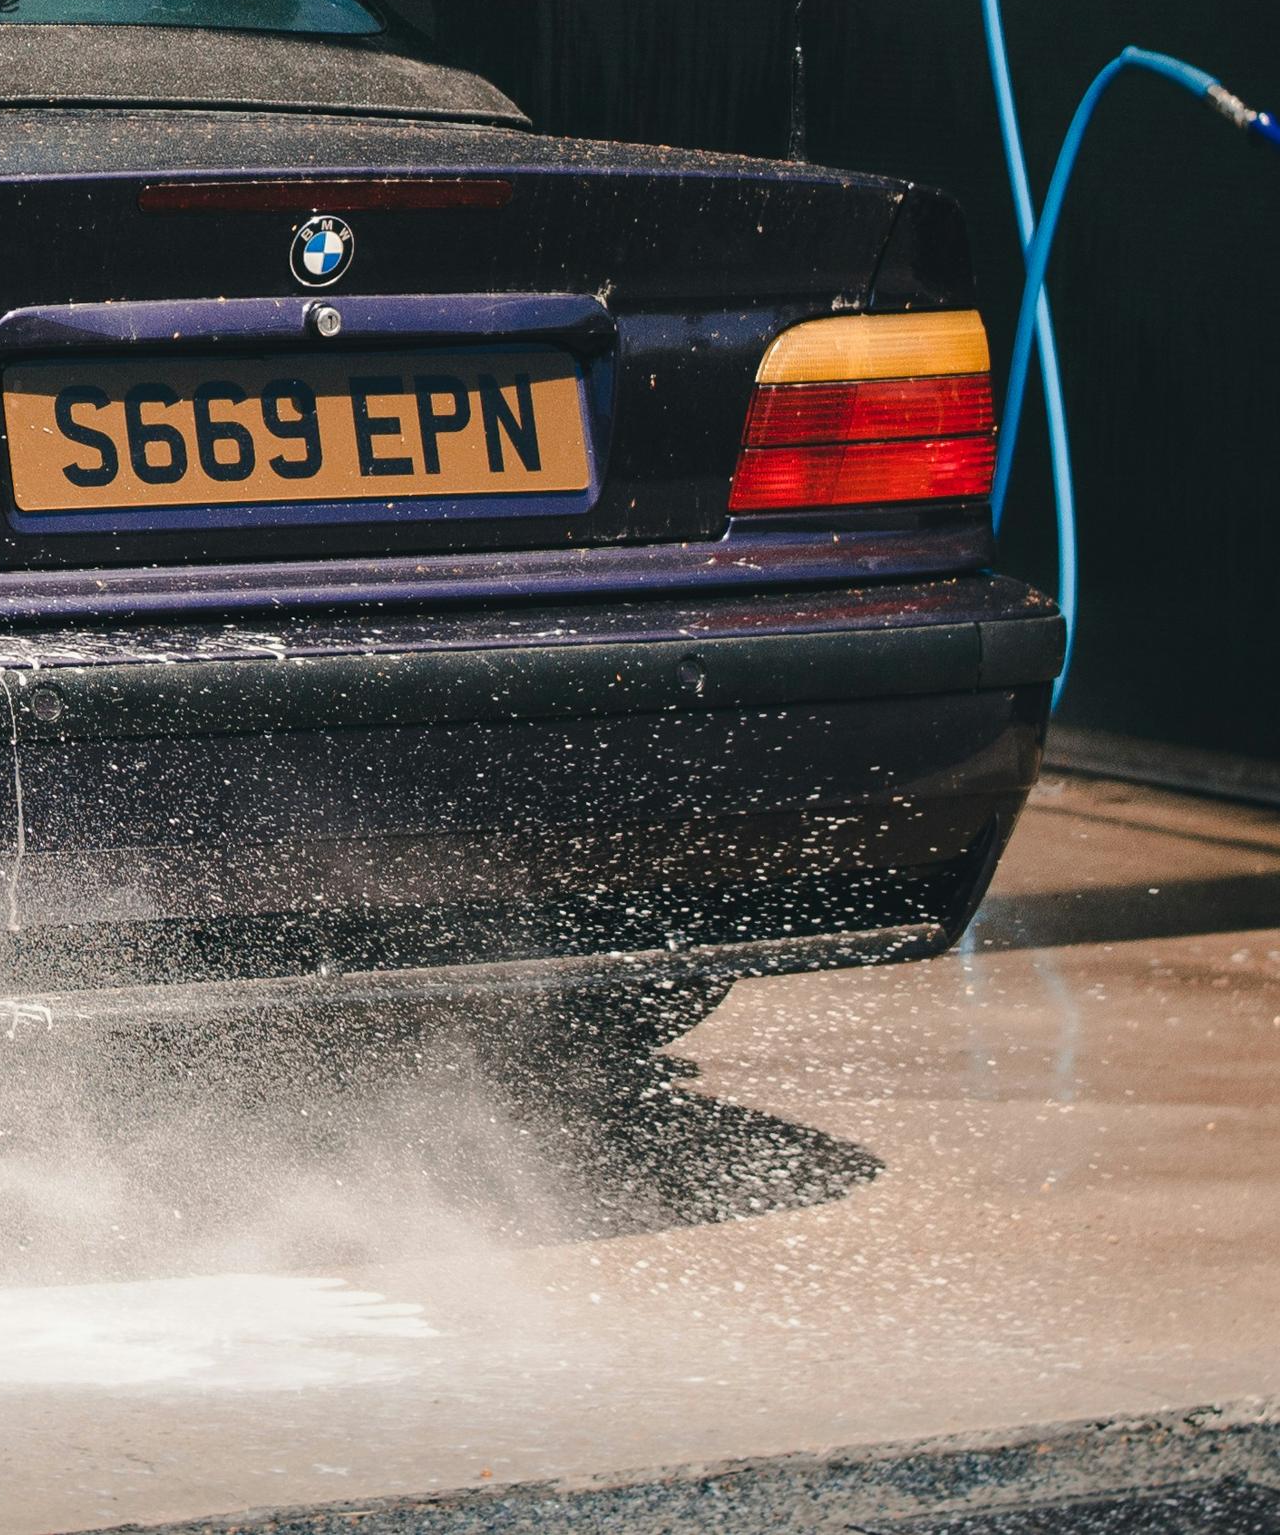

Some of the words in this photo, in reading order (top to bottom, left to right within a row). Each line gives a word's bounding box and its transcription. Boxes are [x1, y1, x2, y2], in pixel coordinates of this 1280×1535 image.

[301, 219, 351, 242] BMW
[53, 378, 324, 488] S669
[348, 372, 543, 478] EPN
